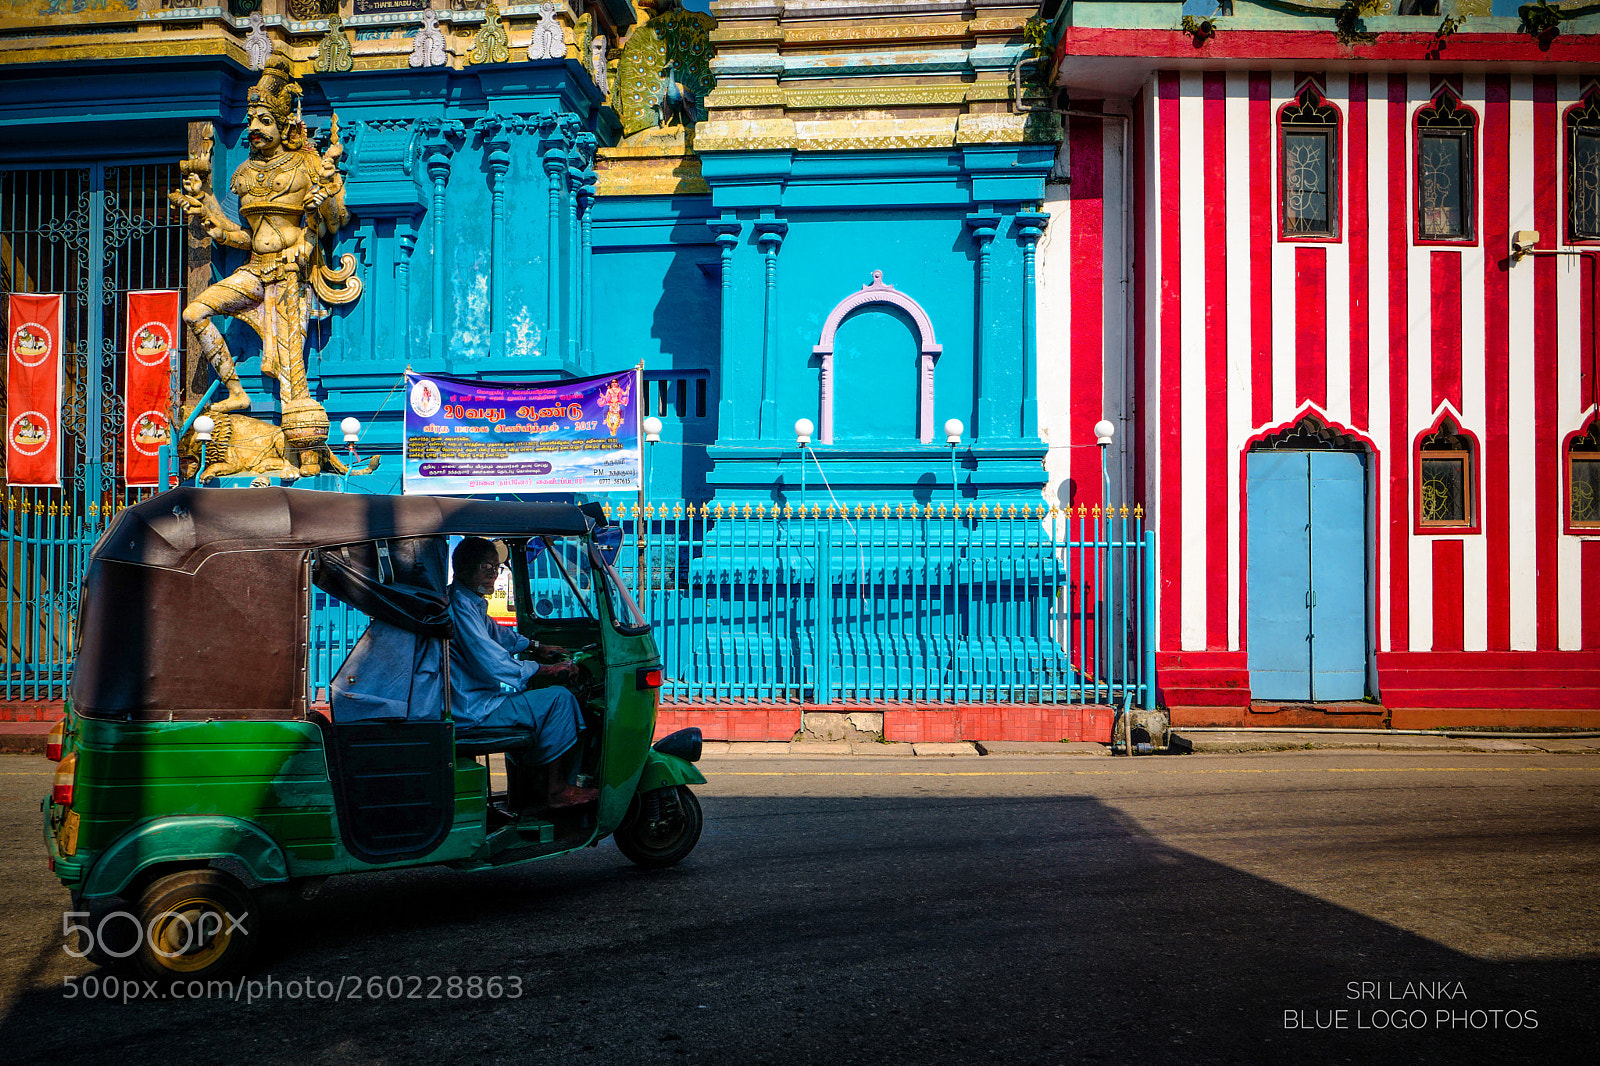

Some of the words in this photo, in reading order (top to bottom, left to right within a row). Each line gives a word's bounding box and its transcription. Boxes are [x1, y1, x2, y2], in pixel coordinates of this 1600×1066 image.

[444, 404, 506, 423] 20வது
[516, 402, 583, 421] ஆண்டு
[574, 420, 598, 431] 2017
